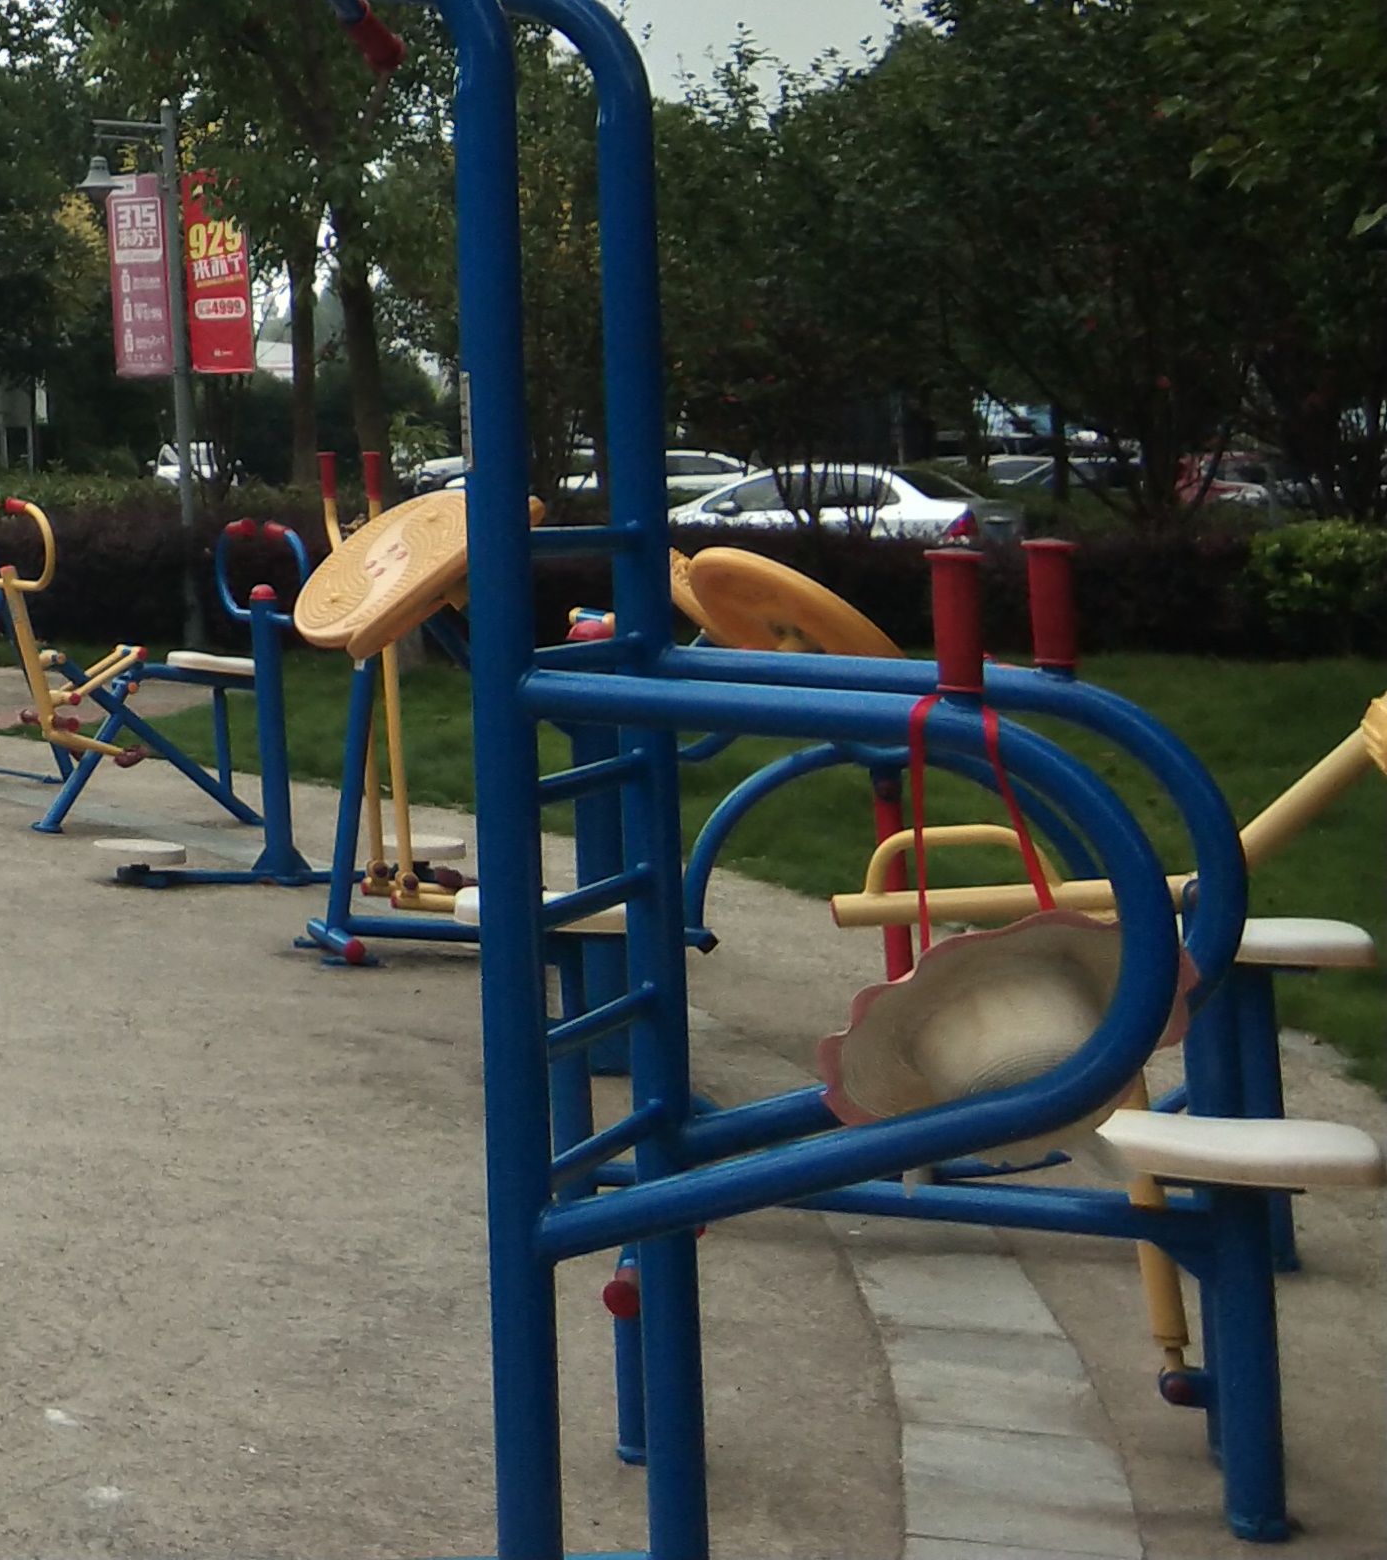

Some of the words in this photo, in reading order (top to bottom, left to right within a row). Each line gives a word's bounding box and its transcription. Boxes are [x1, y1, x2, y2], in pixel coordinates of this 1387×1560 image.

[117, 203, 156, 228] 315
[118, 228, 157, 247] 来苏宁
[192, 251, 244, 281] 来苏宁
